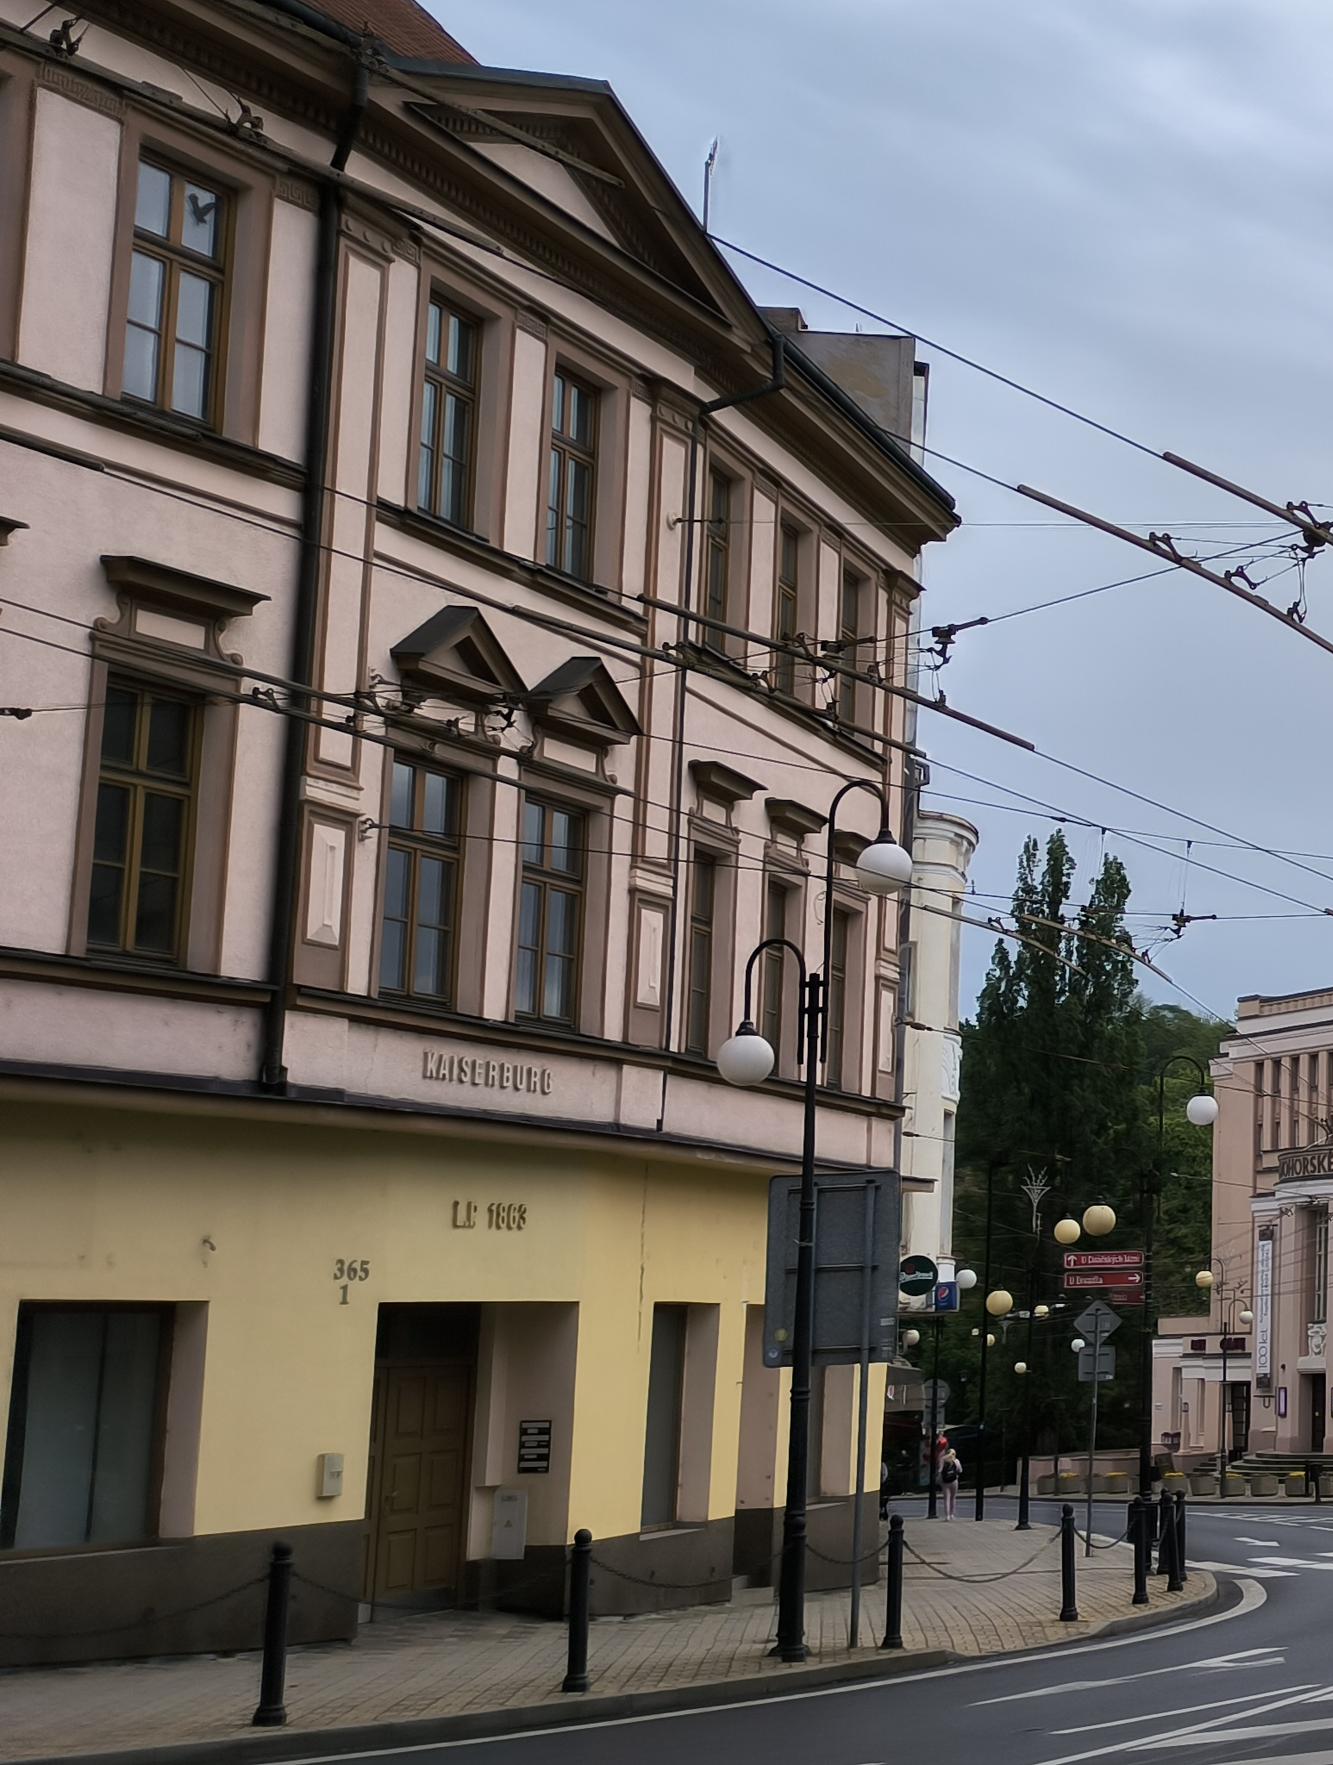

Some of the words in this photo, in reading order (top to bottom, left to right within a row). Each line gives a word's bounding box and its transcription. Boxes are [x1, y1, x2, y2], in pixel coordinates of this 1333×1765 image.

[422, 1050, 553, 1095] KAISERBURG
[333, 1258, 370, 1281] 365
[339, 1284, 351, 1305] 1
[1258, 1346, 1268, 1368] 100
